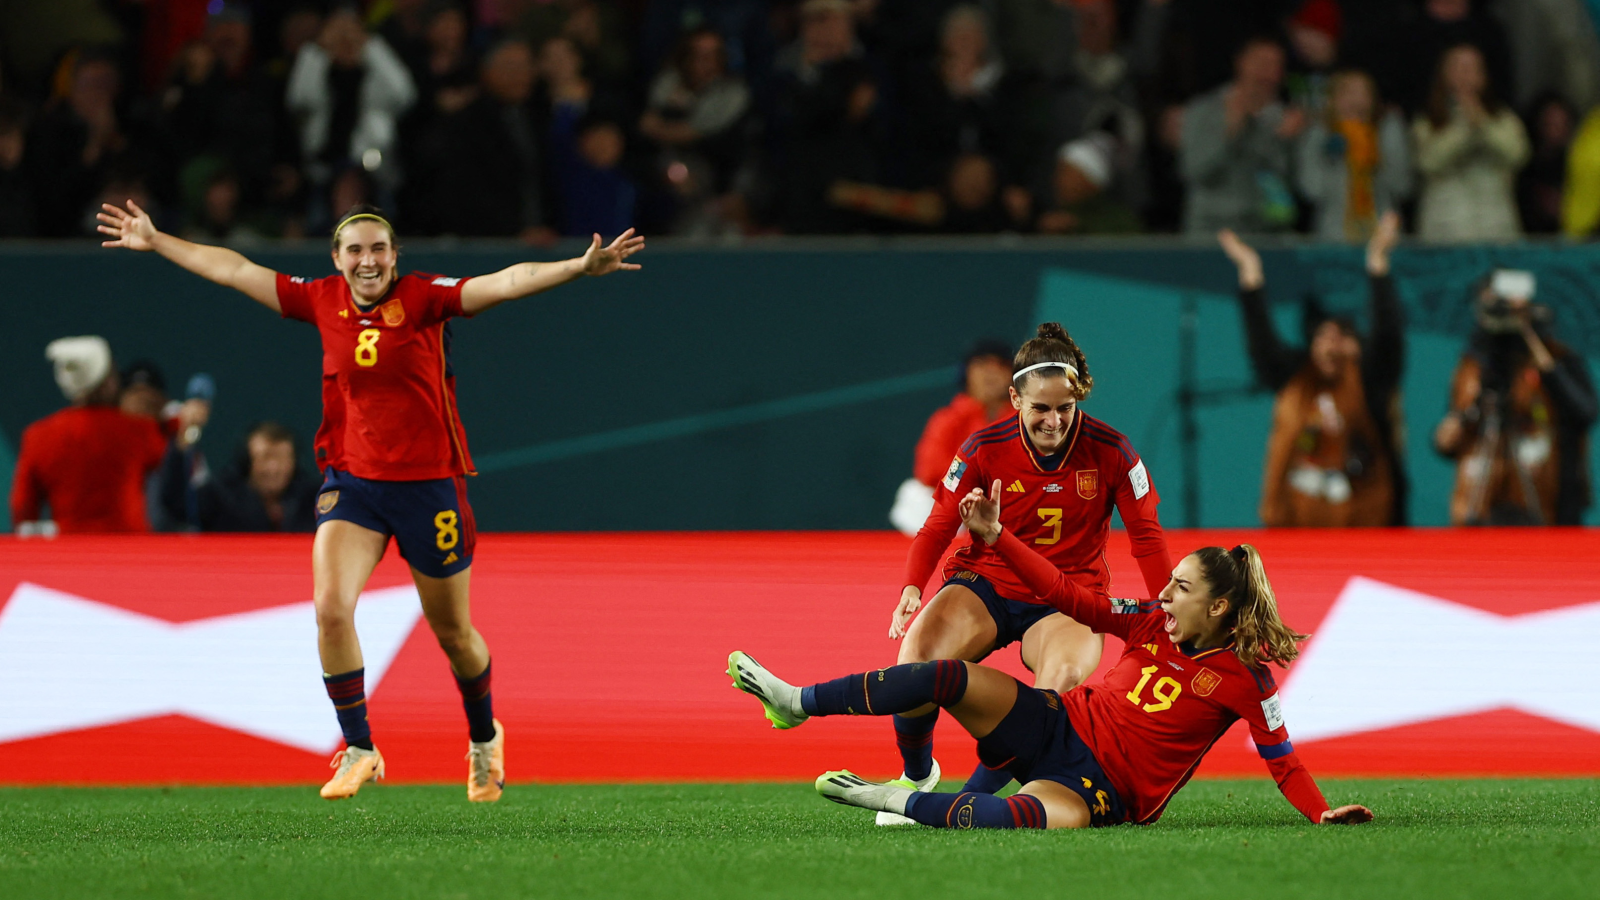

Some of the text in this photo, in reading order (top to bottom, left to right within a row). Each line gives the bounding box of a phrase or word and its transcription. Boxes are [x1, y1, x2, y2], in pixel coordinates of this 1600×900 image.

[355, 329, 381, 366] 8
[435, 510, 458, 549] 8
[1035, 508, 1062, 544] 3
[1126, 663, 1184, 713] 19
